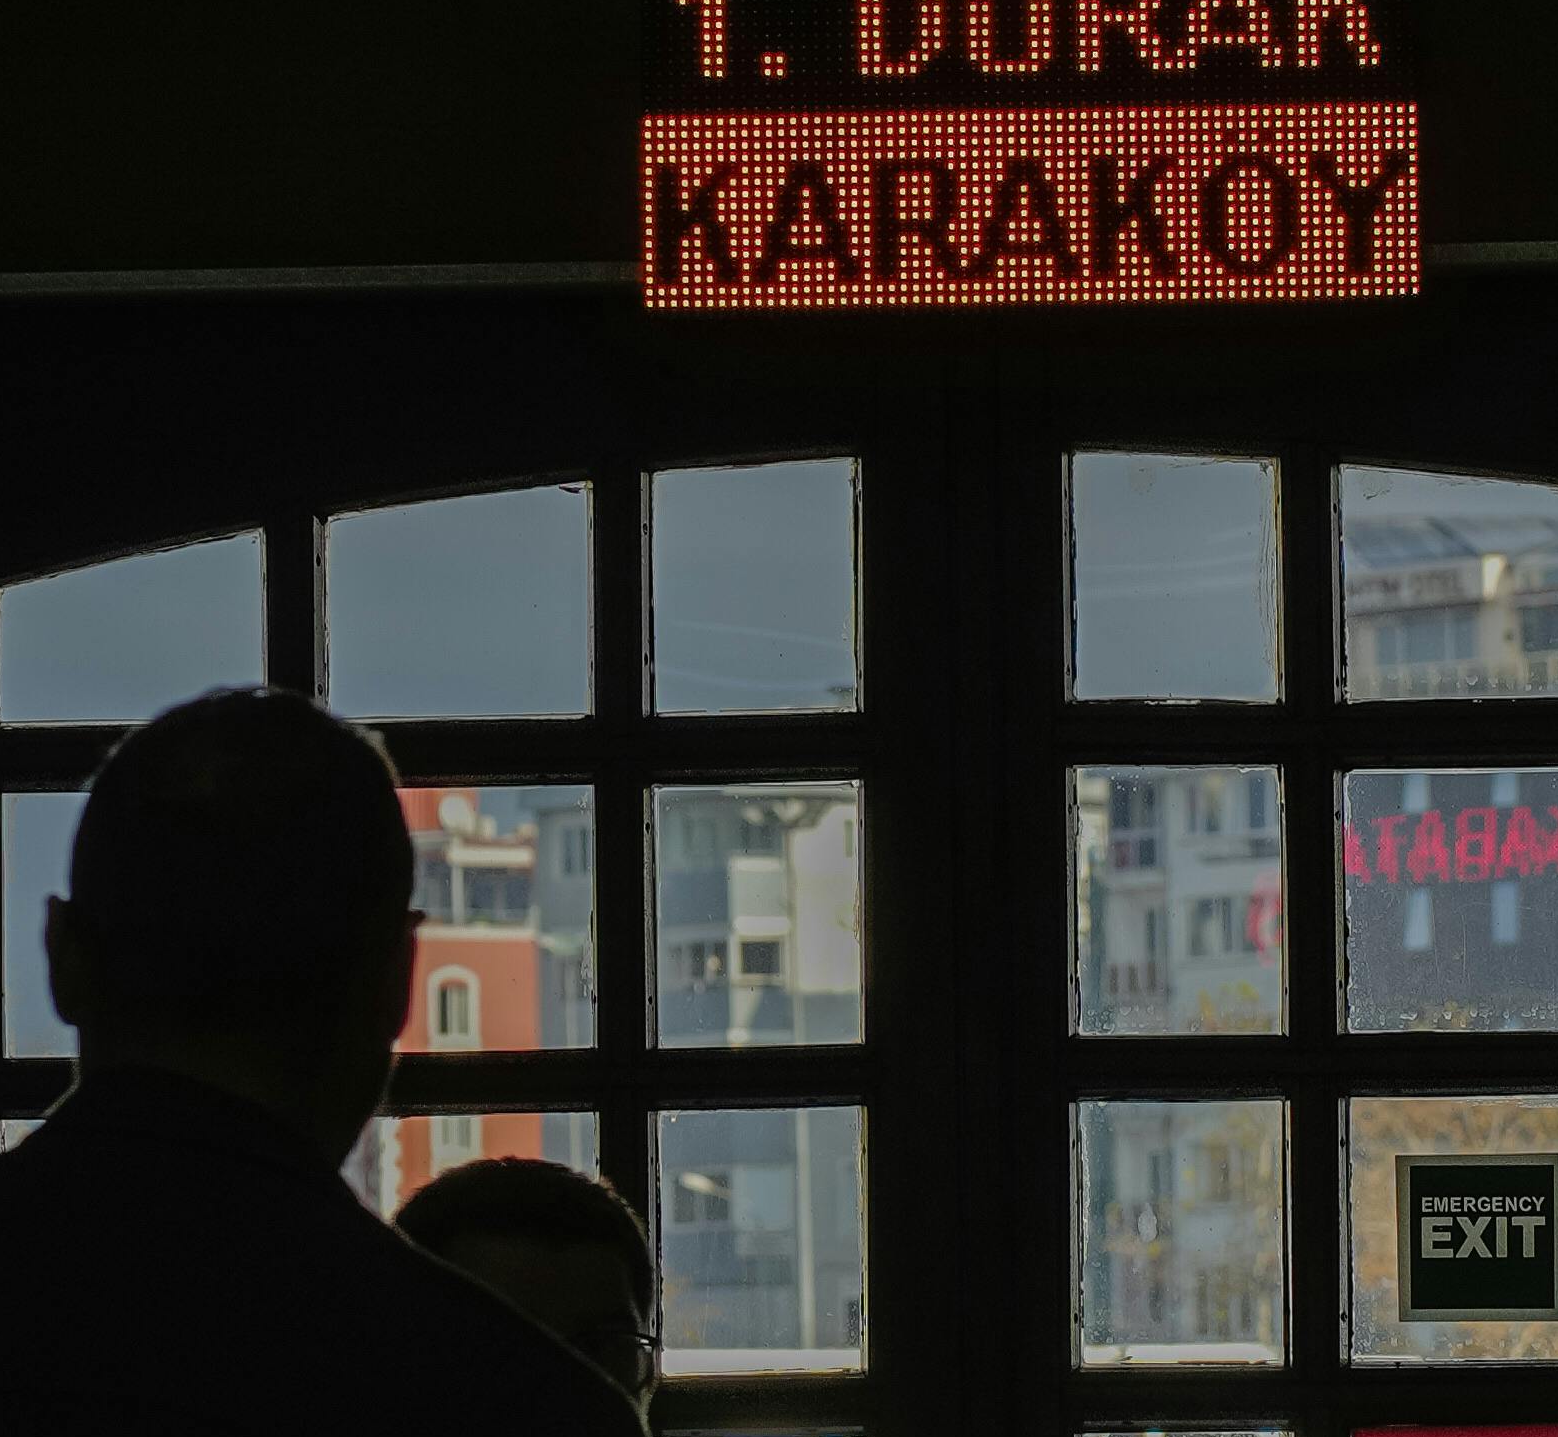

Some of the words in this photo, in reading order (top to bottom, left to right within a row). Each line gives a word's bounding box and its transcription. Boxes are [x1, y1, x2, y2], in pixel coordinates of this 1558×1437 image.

[653, 129, 1413, 287] KARAKÖY
[1421, 1196, 1545, 1213] EMERGENCY
[1421, 1216, 1546, 1259] EXIT
